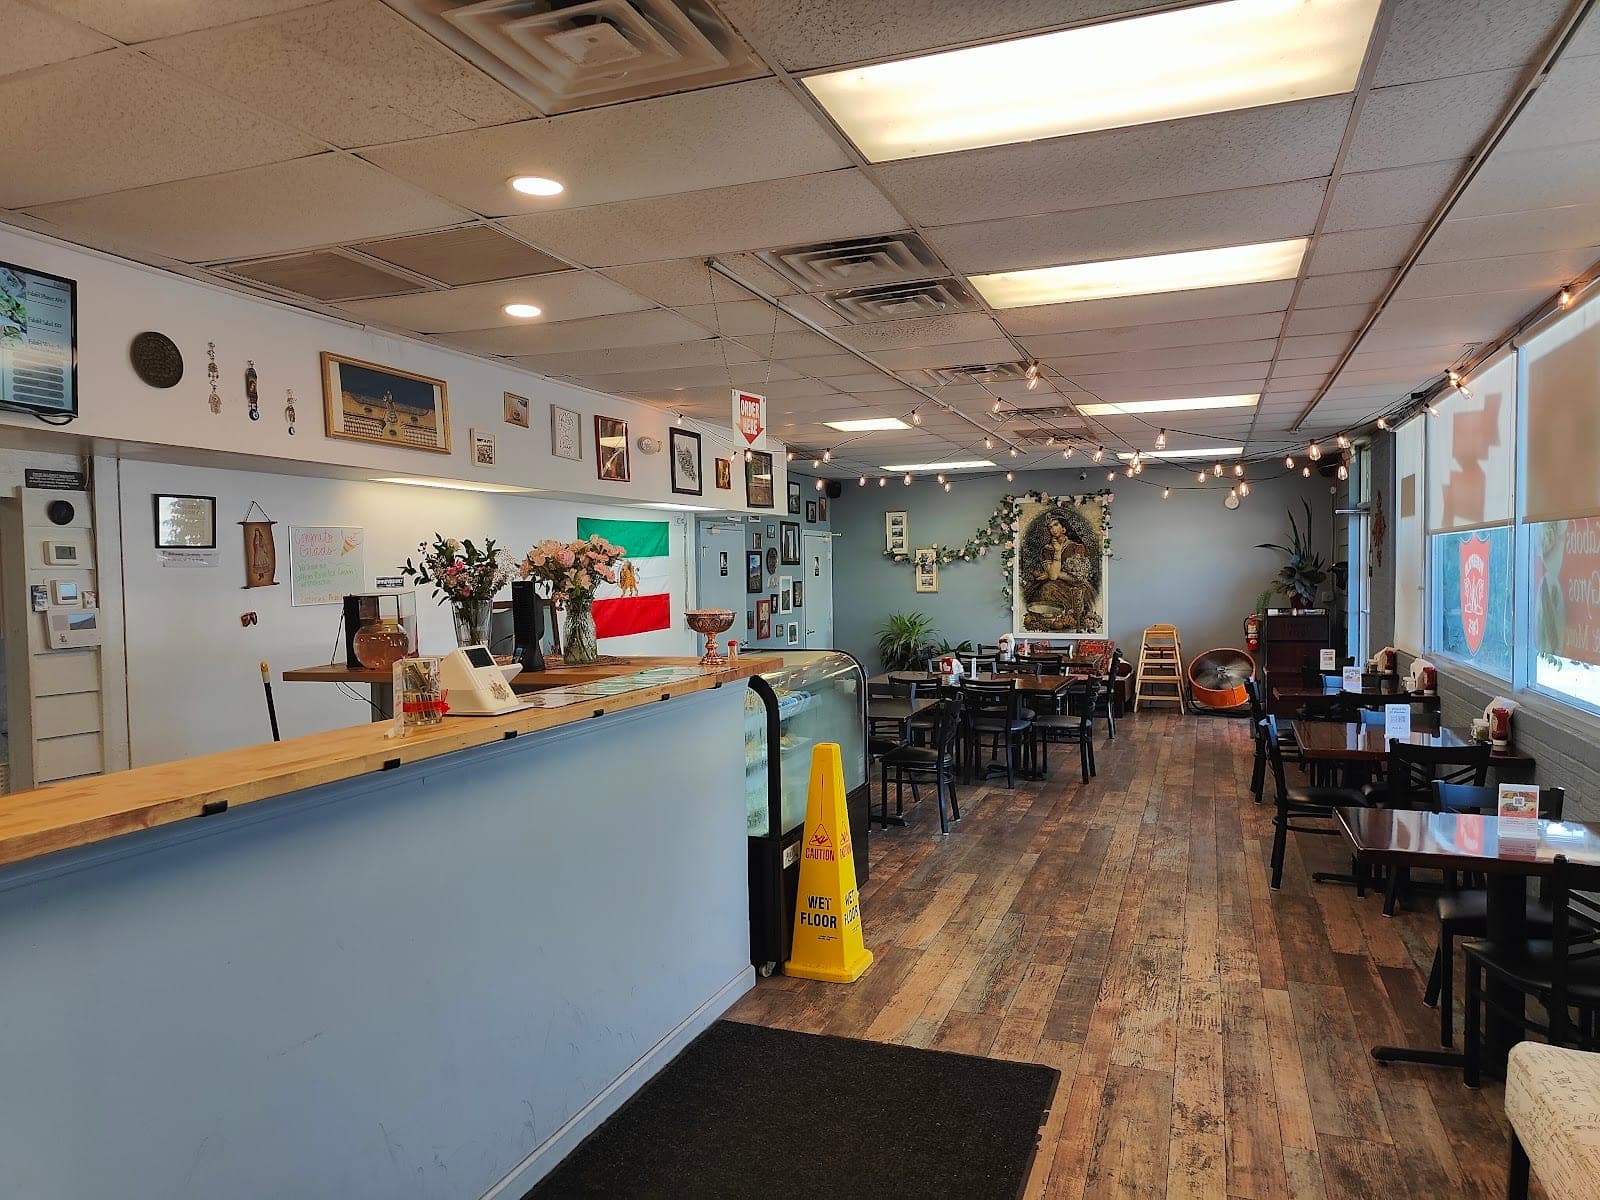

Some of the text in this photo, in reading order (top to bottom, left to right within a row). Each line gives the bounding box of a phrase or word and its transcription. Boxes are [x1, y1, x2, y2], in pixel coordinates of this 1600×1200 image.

[741, 399, 759, 419] ORDER
[743, 417, 758, 435] HERE
[806, 848, 834, 861] CAUTION
[808, 896, 831, 910] WET
[800, 912, 837, 929] FLOOR
